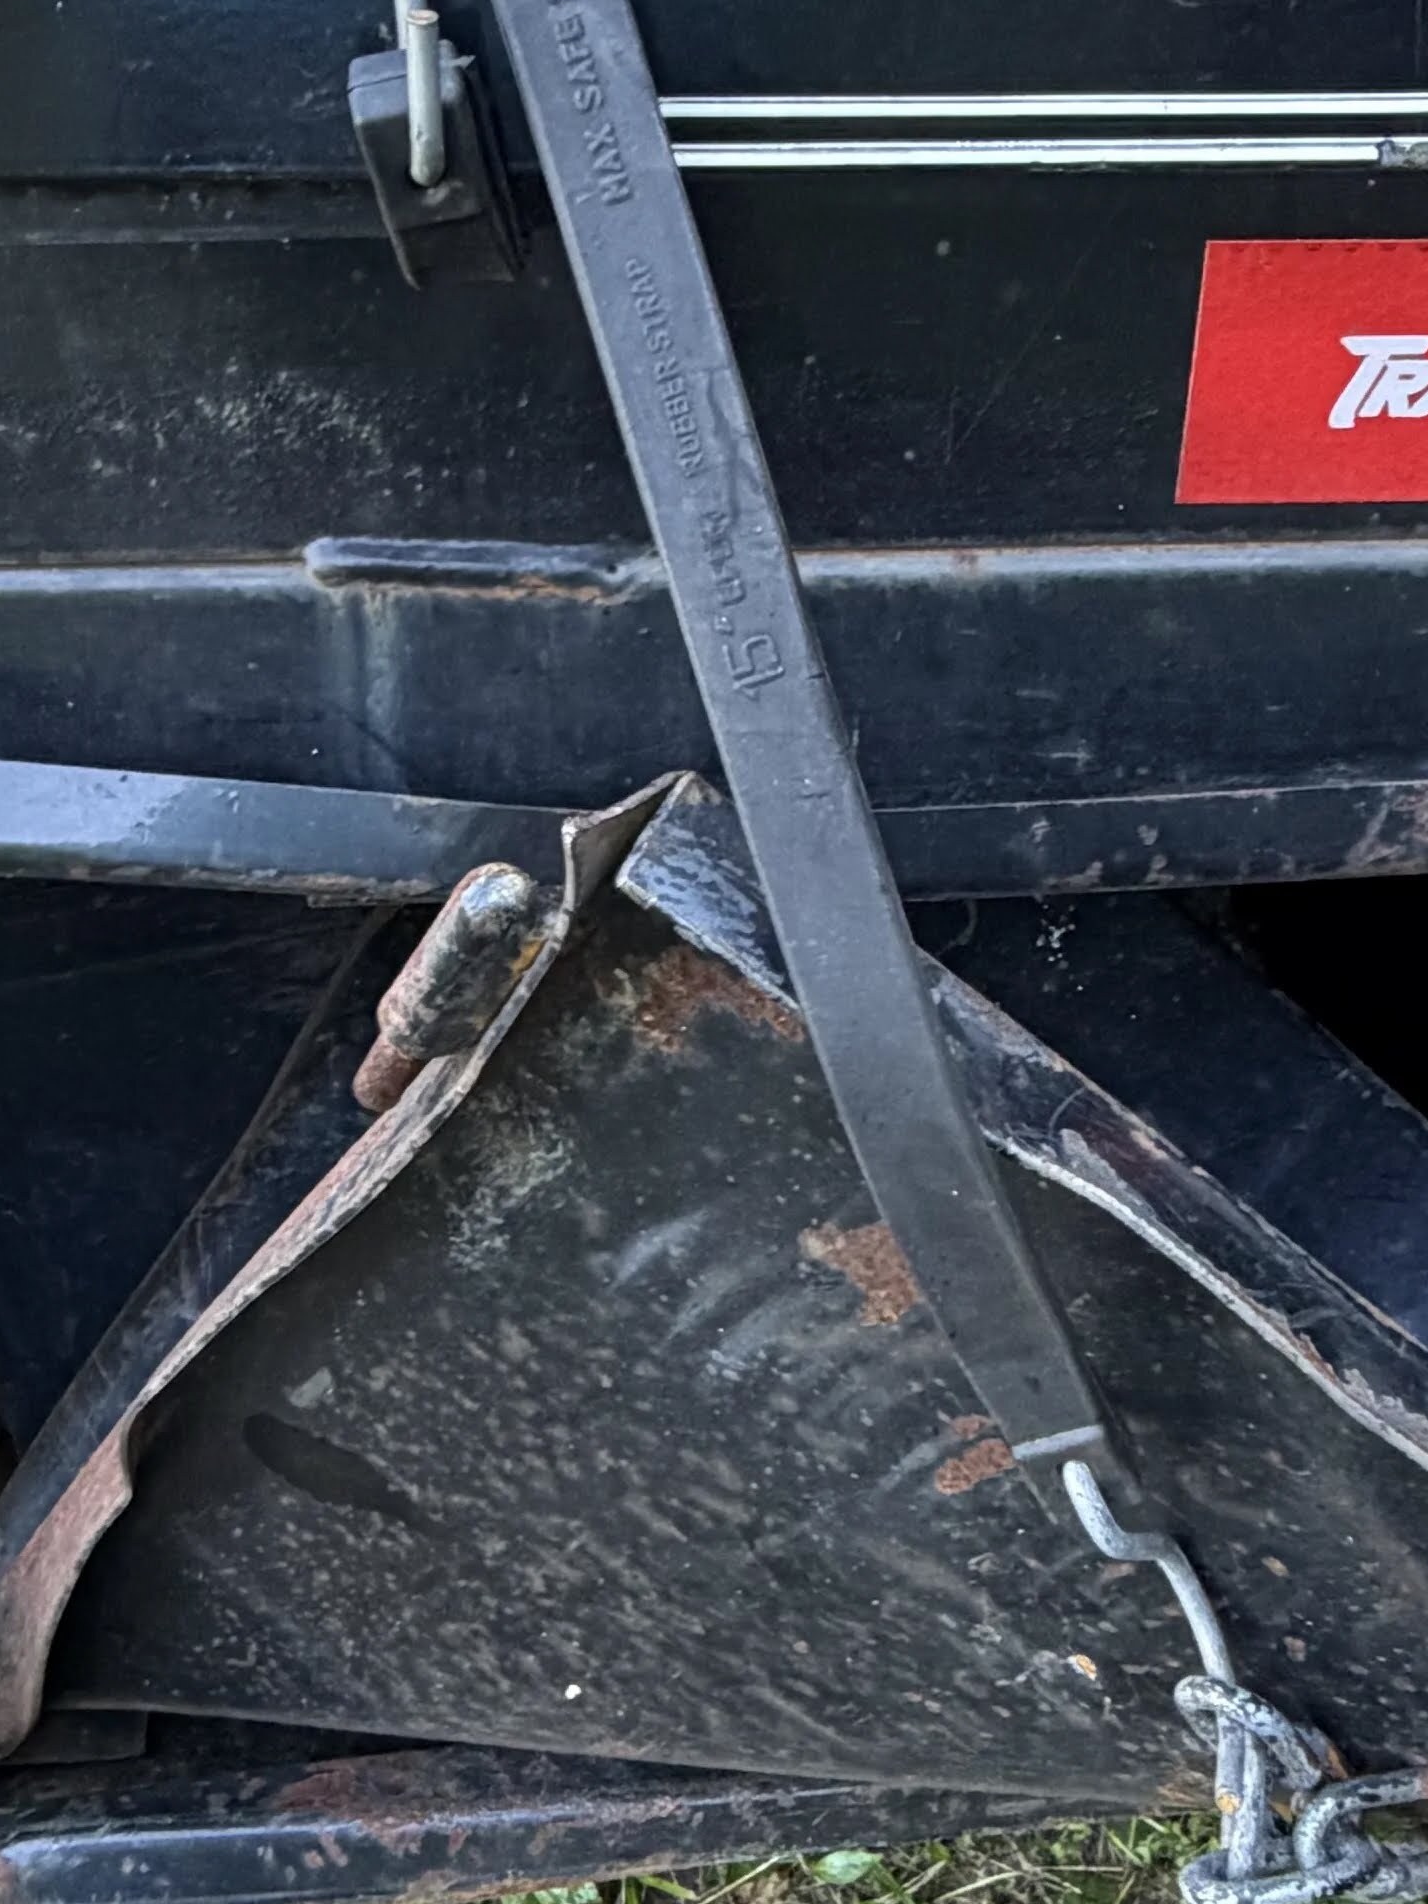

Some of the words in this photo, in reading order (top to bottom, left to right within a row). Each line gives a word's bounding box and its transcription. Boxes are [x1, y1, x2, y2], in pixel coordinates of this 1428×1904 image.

[551, 14, 605, 113] SAFE
[581, 122, 631, 206] MAX
[622, 257, 674, 356] STRAP
